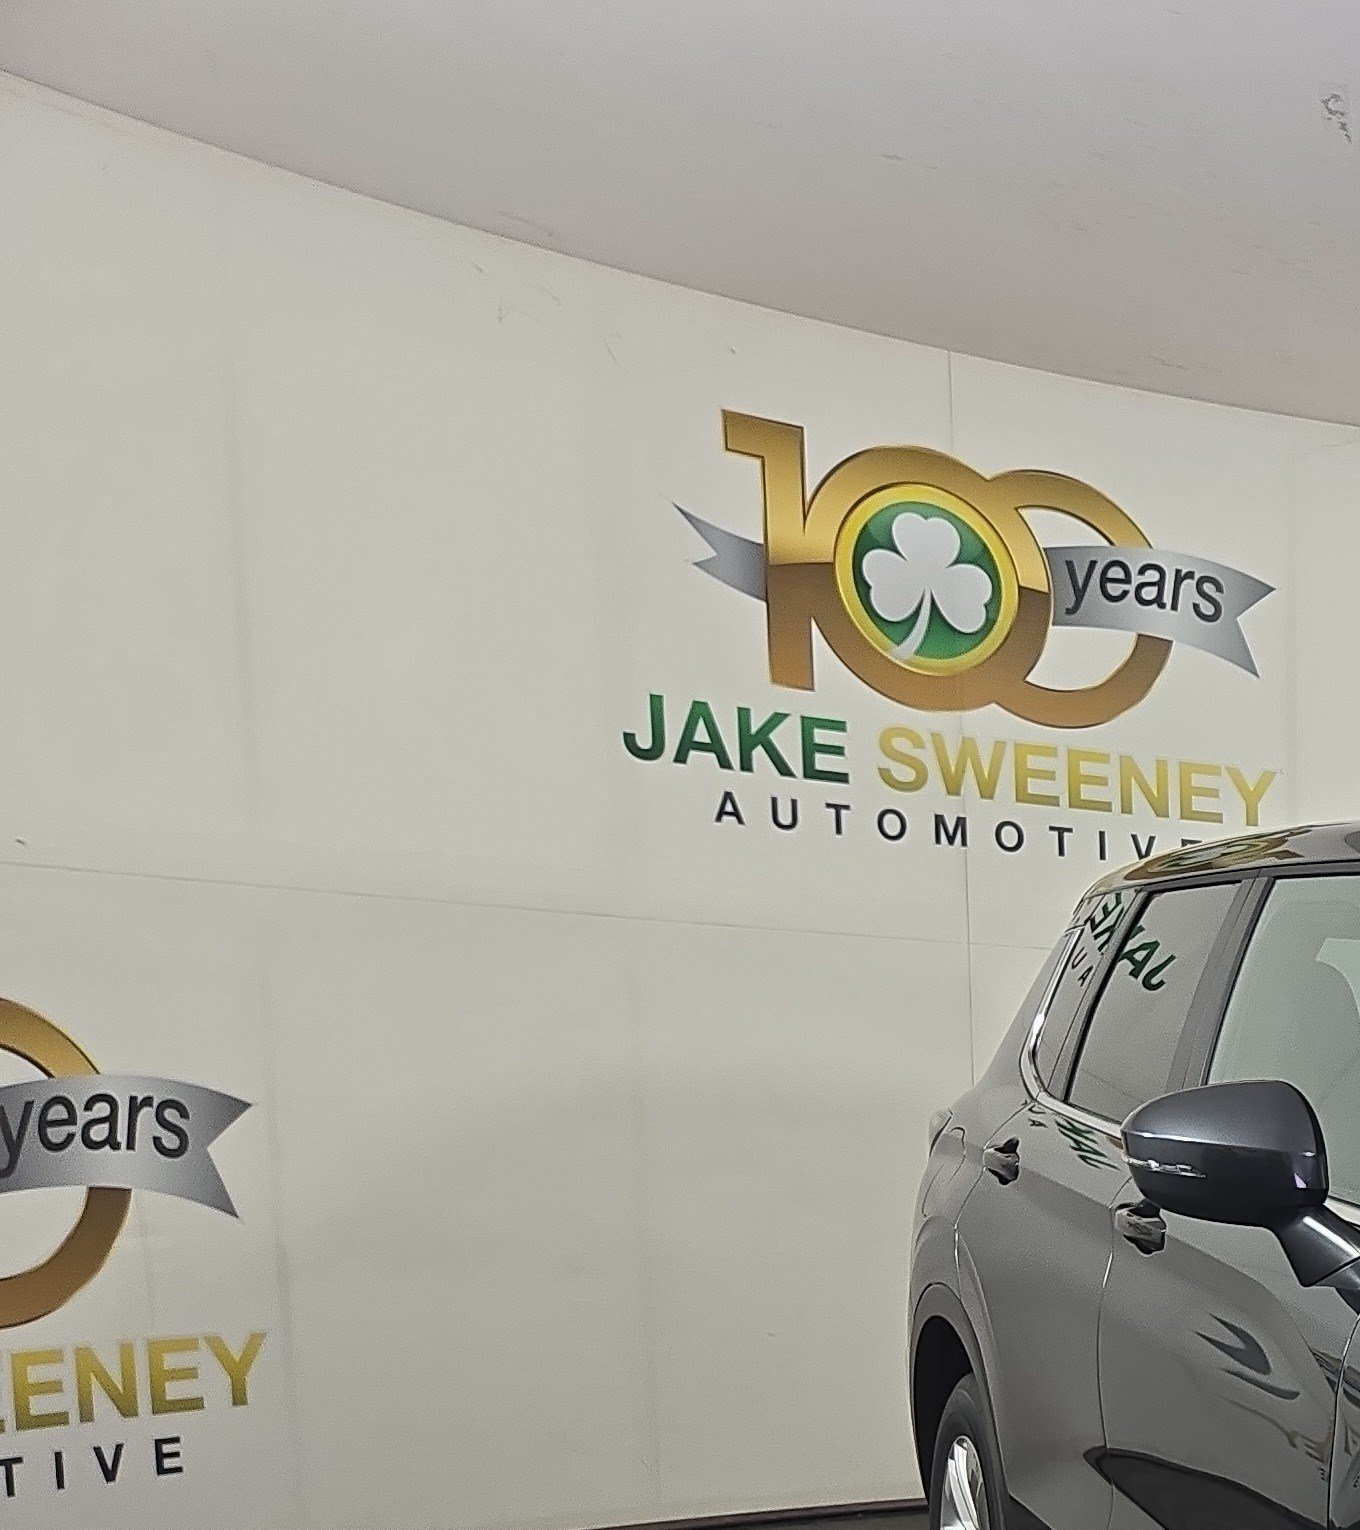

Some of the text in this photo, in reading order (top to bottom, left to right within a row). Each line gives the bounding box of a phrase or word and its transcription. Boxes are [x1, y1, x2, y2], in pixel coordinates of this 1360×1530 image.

[1064, 551, 1225, 624] years
[622, 694, 1277, 827] JAKE SWEENEY
[714, 790, 1203, 861] AUTOMOTIV
[0, 1093, 190, 1176] years
[0, 1332, 266, 1432] ENEY
